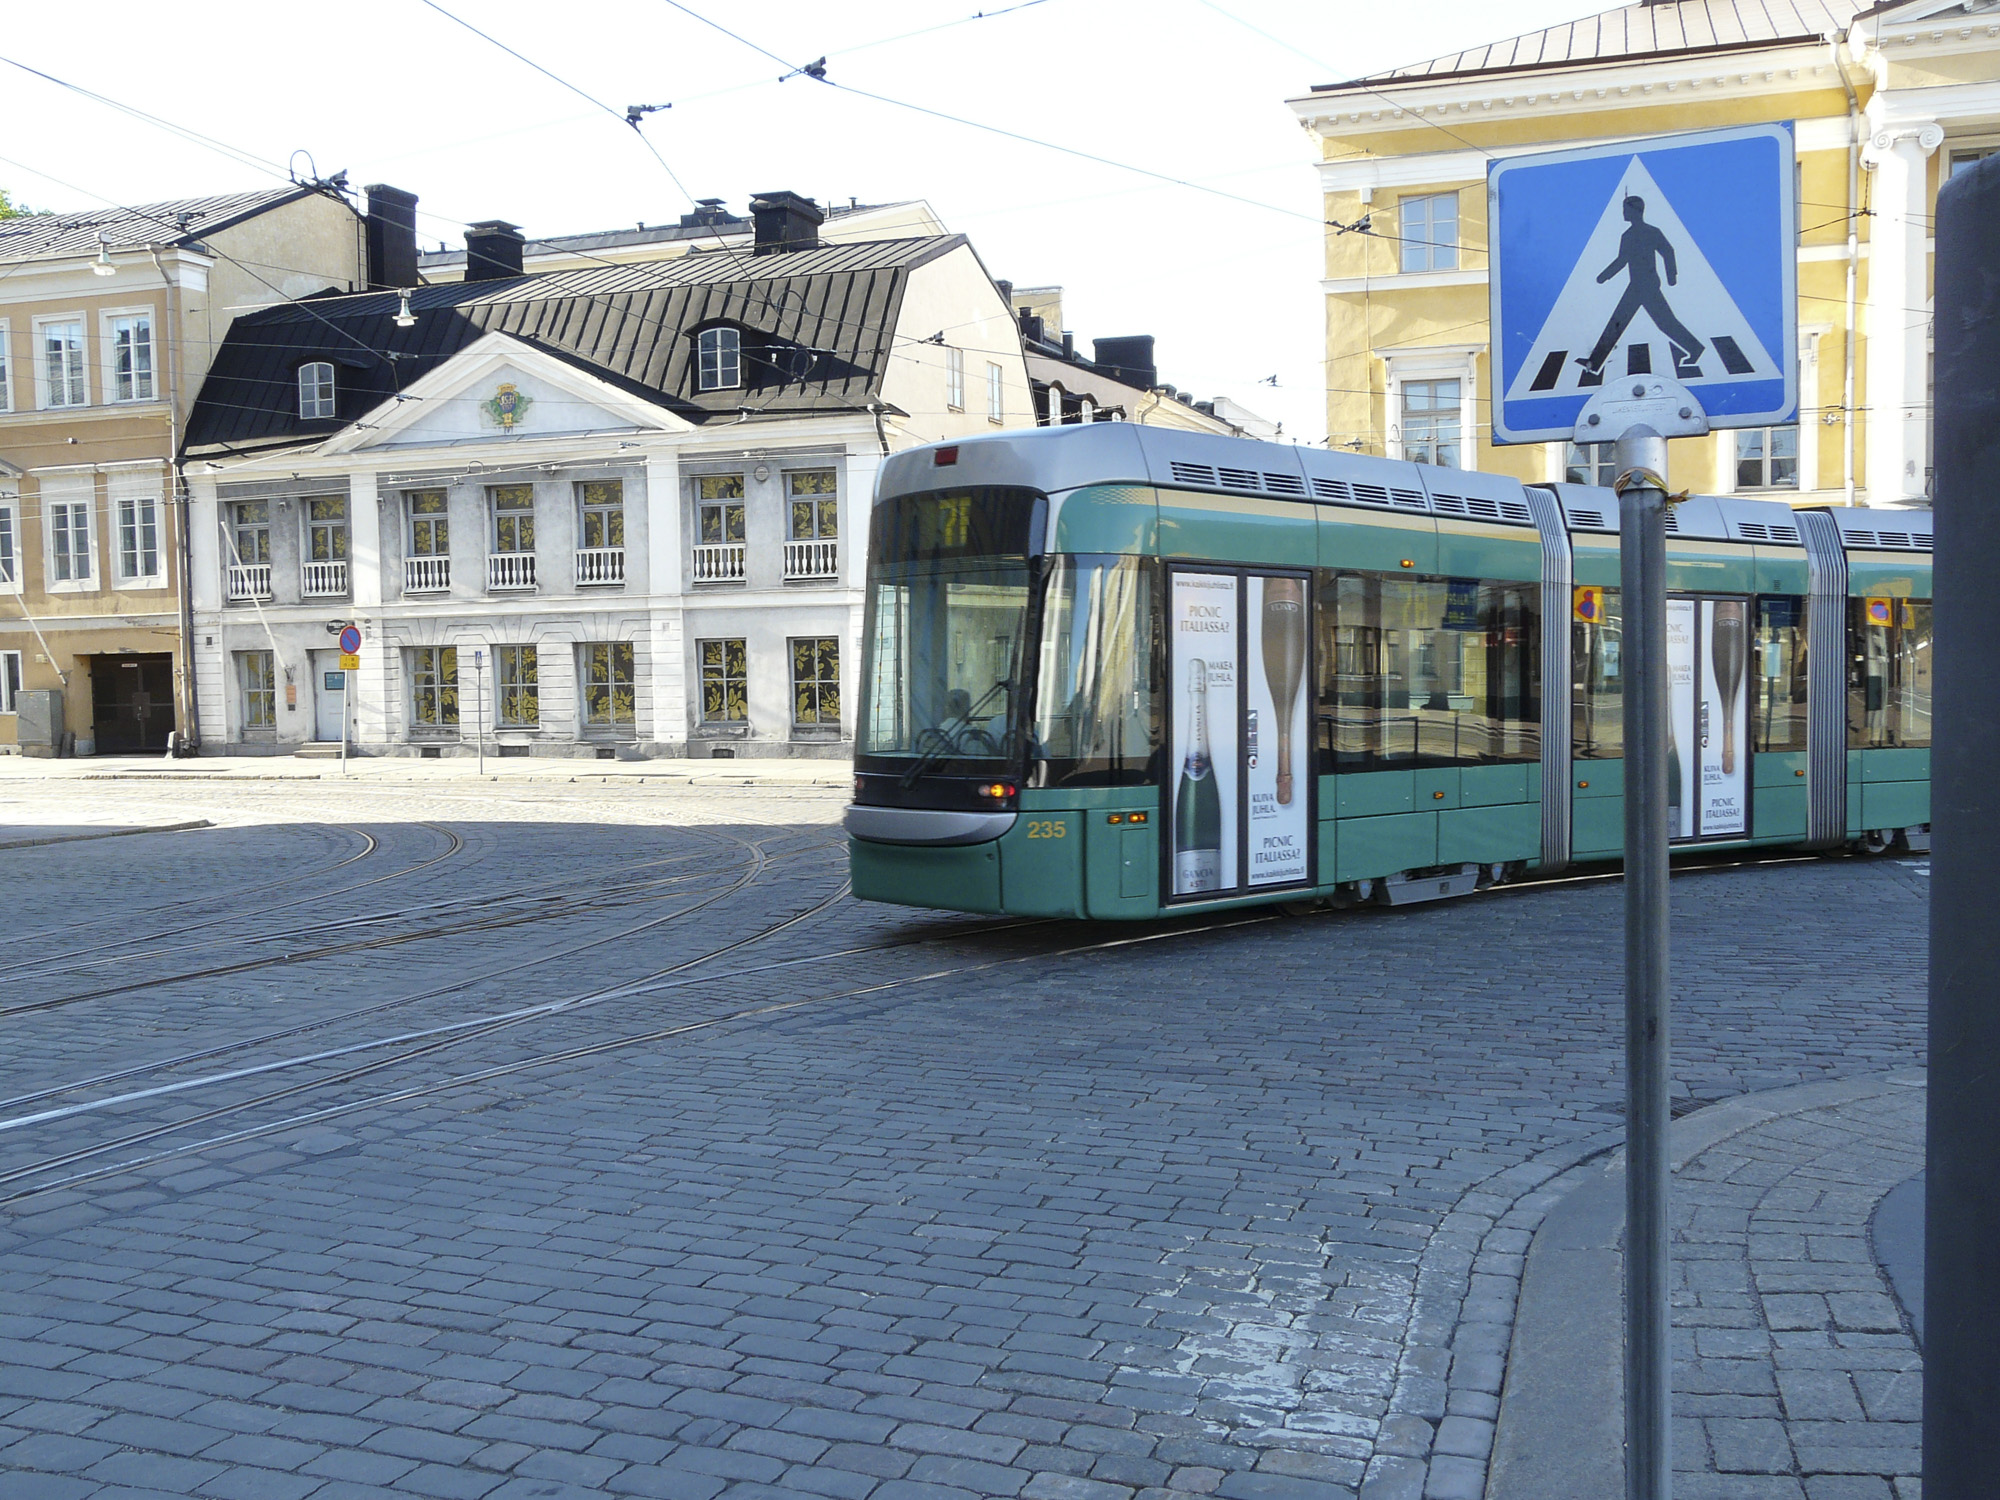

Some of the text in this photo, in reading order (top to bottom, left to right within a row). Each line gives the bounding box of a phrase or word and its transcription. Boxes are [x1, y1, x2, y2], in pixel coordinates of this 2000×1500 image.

[1189, 605, 1222, 618] PICNIC
[1180, 620, 1230, 633] ITALIASSA?
[1208, 661, 1233, 670] MAKEA
[1252, 793, 1275, 803] KUIVA
[1711, 797, 1735, 807] PICNIC
[1705, 808, 1740, 819] ITALIASSA?
[1027, 820, 1067, 839] 235
[1263, 834, 1293, 848] PICNIC
[1255, 848, 1301, 864] ITALIASSA?
[1182, 867, 1213, 879] GANCIA
